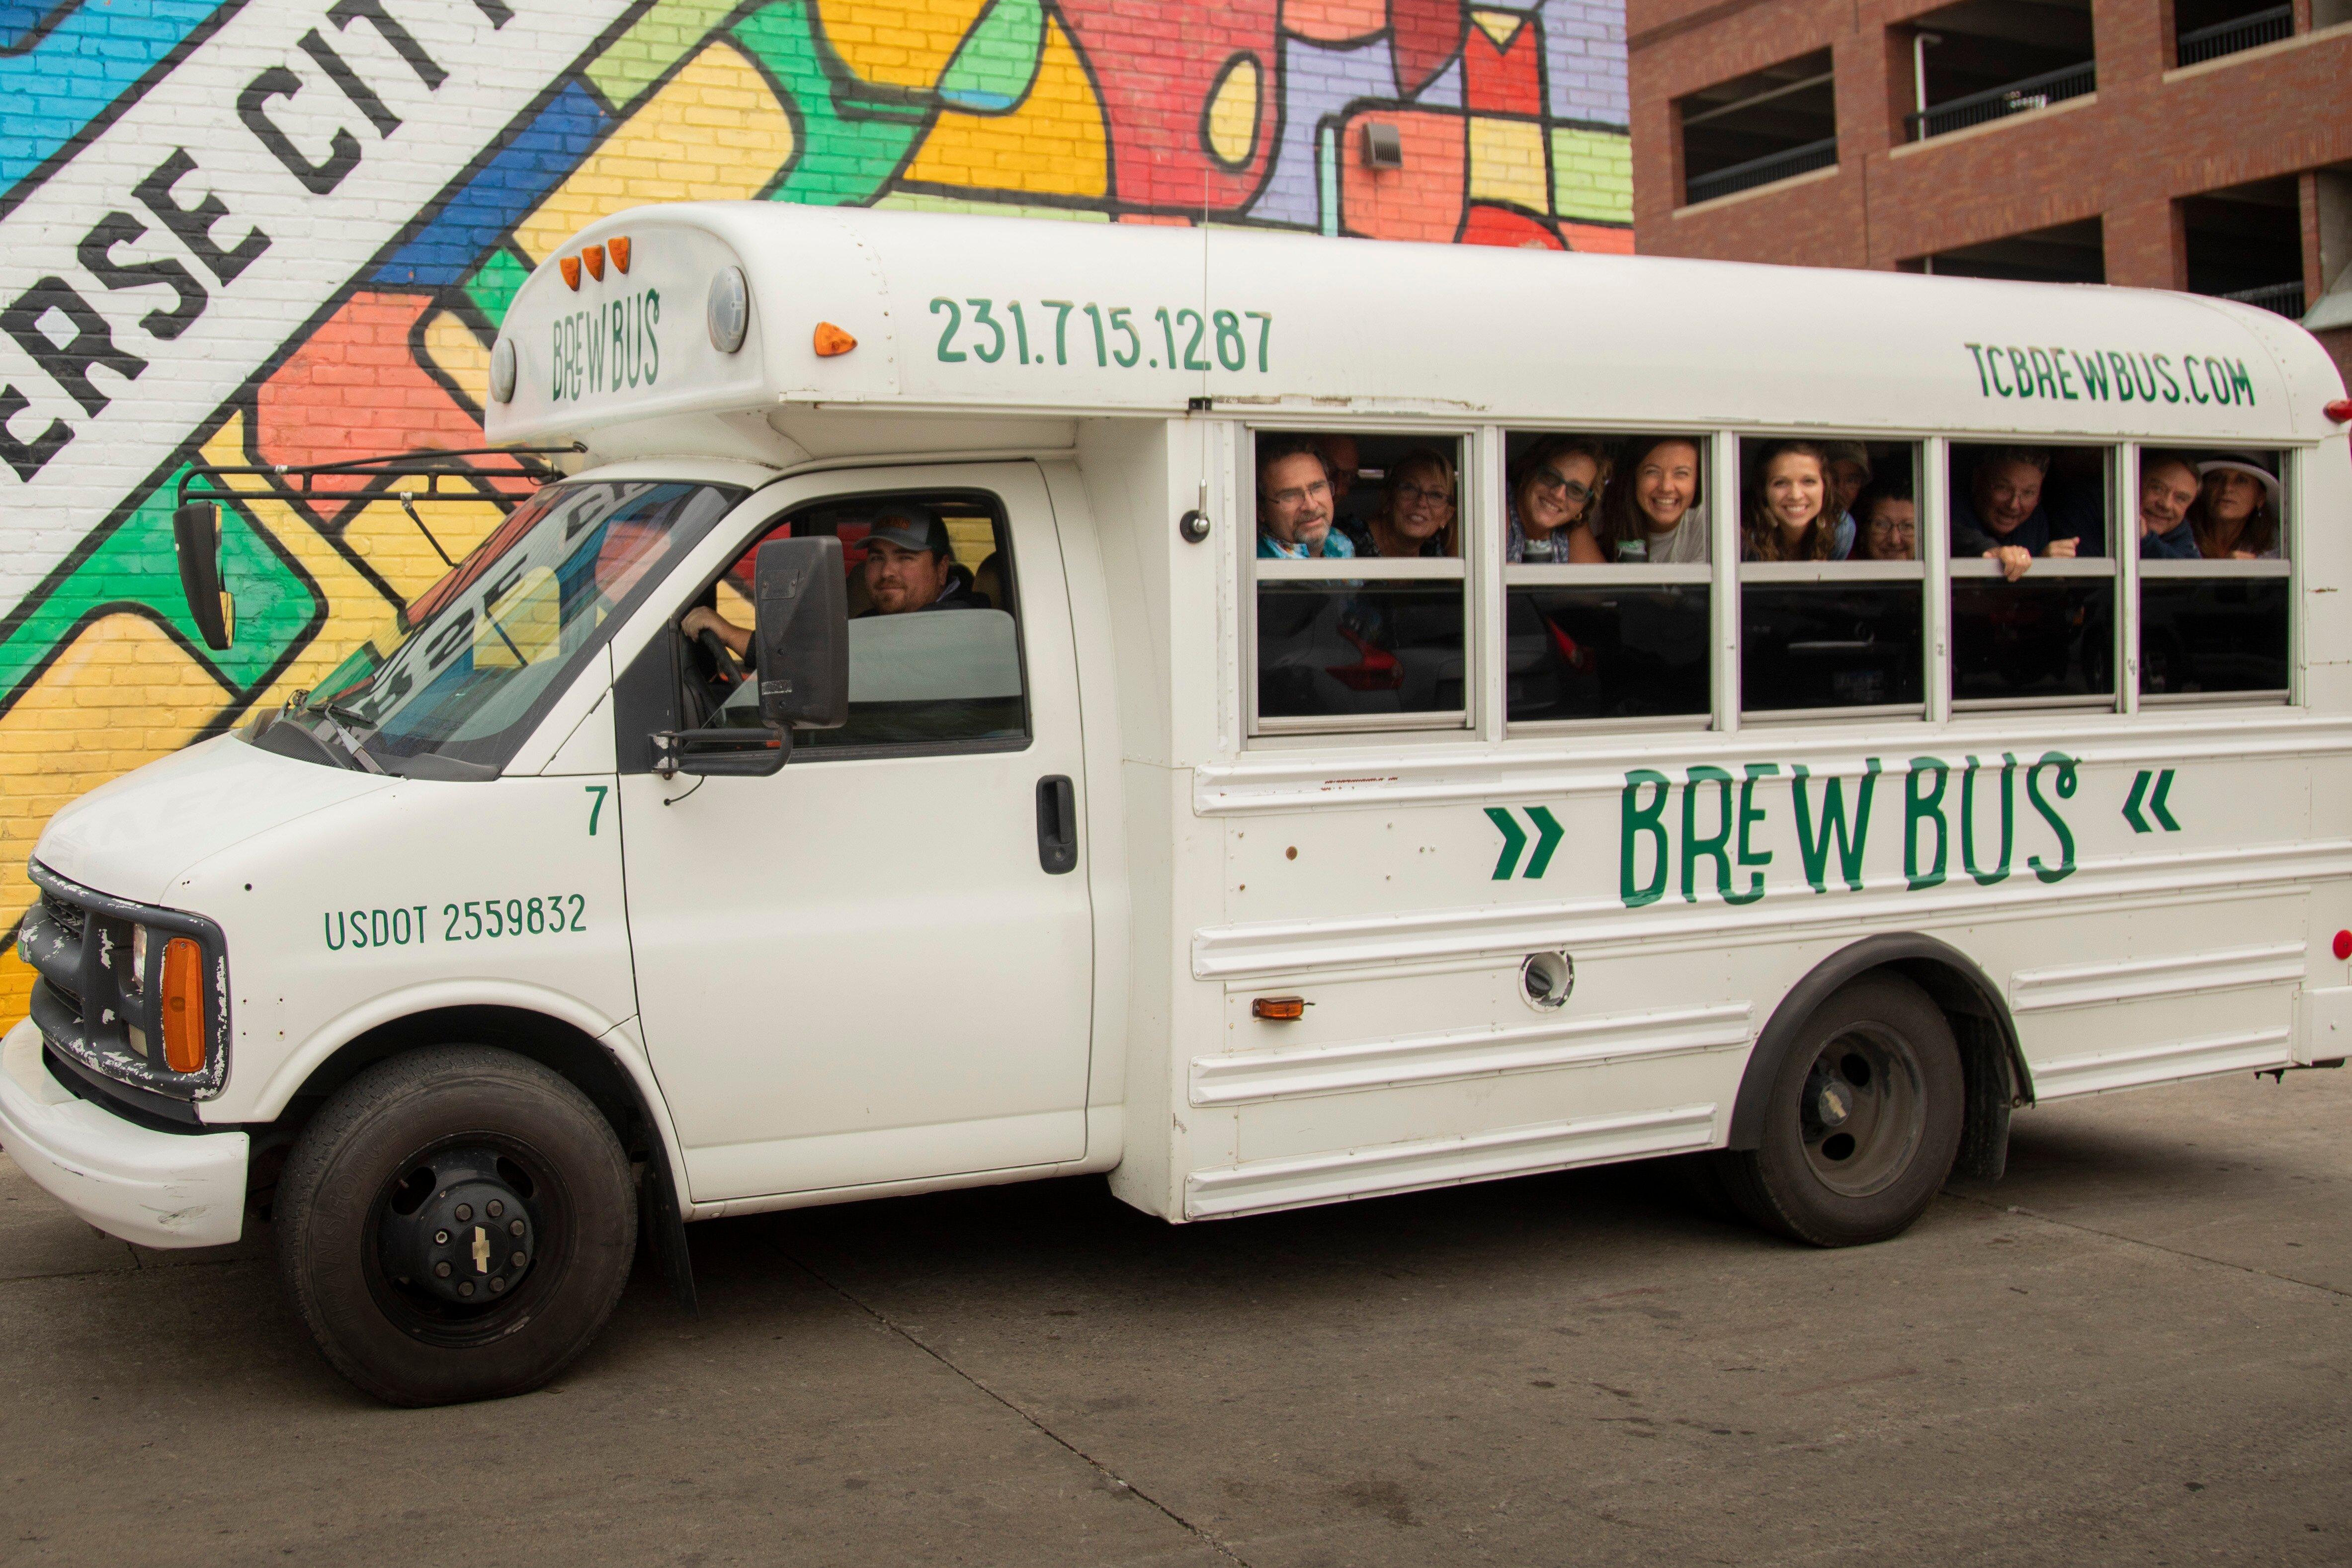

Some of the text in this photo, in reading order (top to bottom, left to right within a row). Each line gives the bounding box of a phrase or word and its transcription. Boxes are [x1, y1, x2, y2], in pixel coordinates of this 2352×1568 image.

[236, 0, 514, 195] CIT
[553, 287, 660, 402] BREW BUS
[928, 296, 1272, 373] 231.715.1287
[1964, 342, 2257, 407] TCBREWBUS.COM
[584, 785, 608, 837] 7
[1620, 750, 2083, 909] BREW BUS
[324, 893, 587, 952] USDOT 2559832
[318, 1119, 401, 1329] TRANSFORCE
